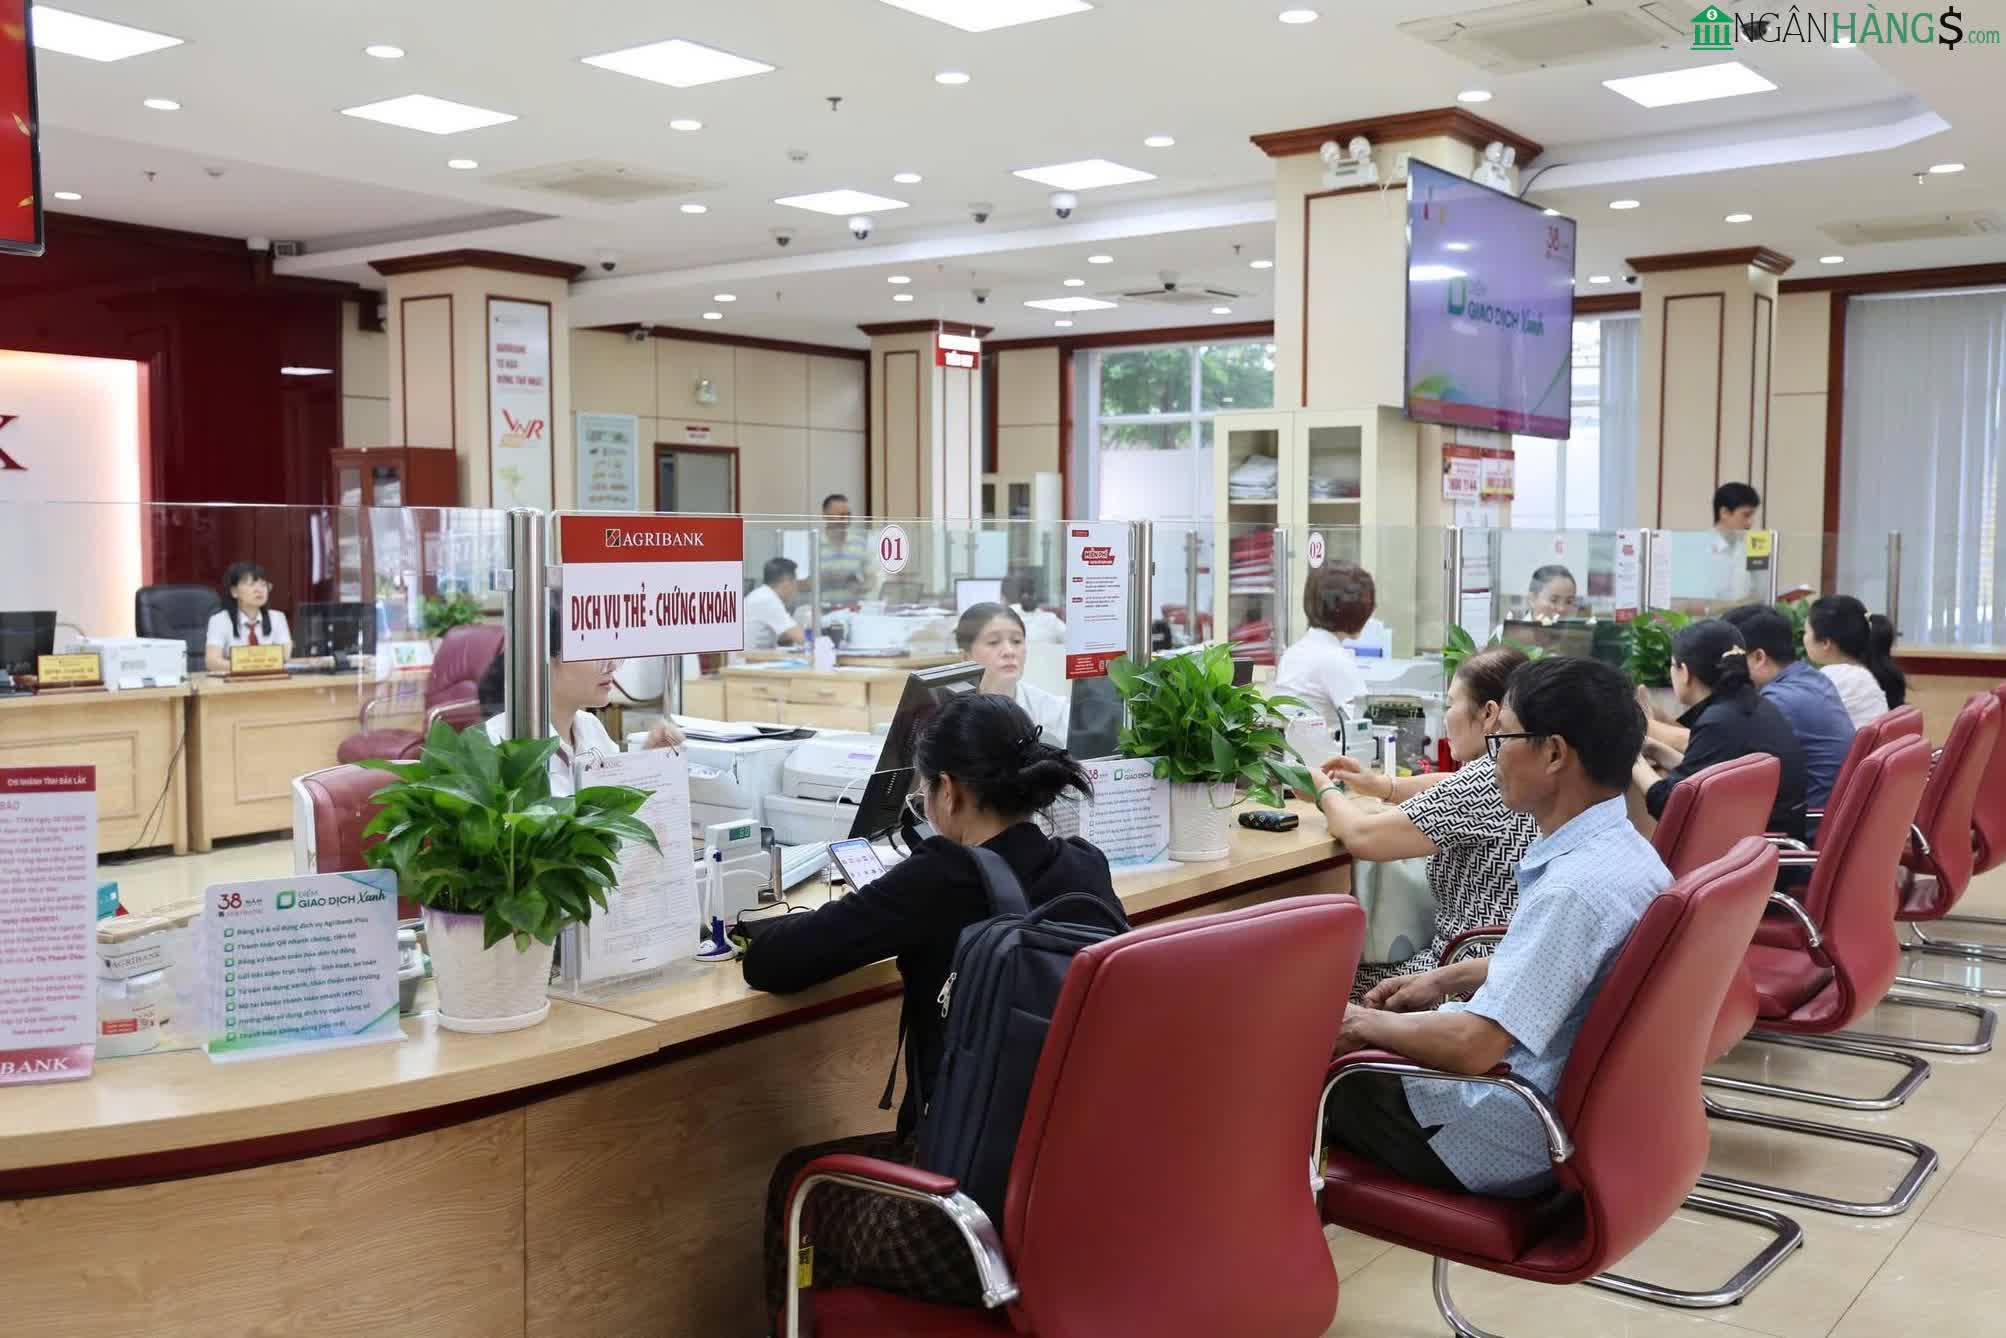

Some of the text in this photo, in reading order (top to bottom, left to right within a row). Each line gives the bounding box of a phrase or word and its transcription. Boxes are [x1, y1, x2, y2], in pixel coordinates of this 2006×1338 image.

[623, 531, 704, 547] AGRIBANK
[881, 538, 903, 561] 01
[1310, 542, 1321, 560] 02
[571, 594, 601, 641] DỊCH
[604, 594, 621, 640] VỤ
[624, 582, 647, 629] THẺ
[656, 585, 696, 627] CHỨNG
[699, 585, 737, 625] KHOÁN
[217, 893, 242, 910] 38
[298, 888, 386, 908] GIAO DỊCH Xanh
[0, 1057, 69, 1075] BANK
